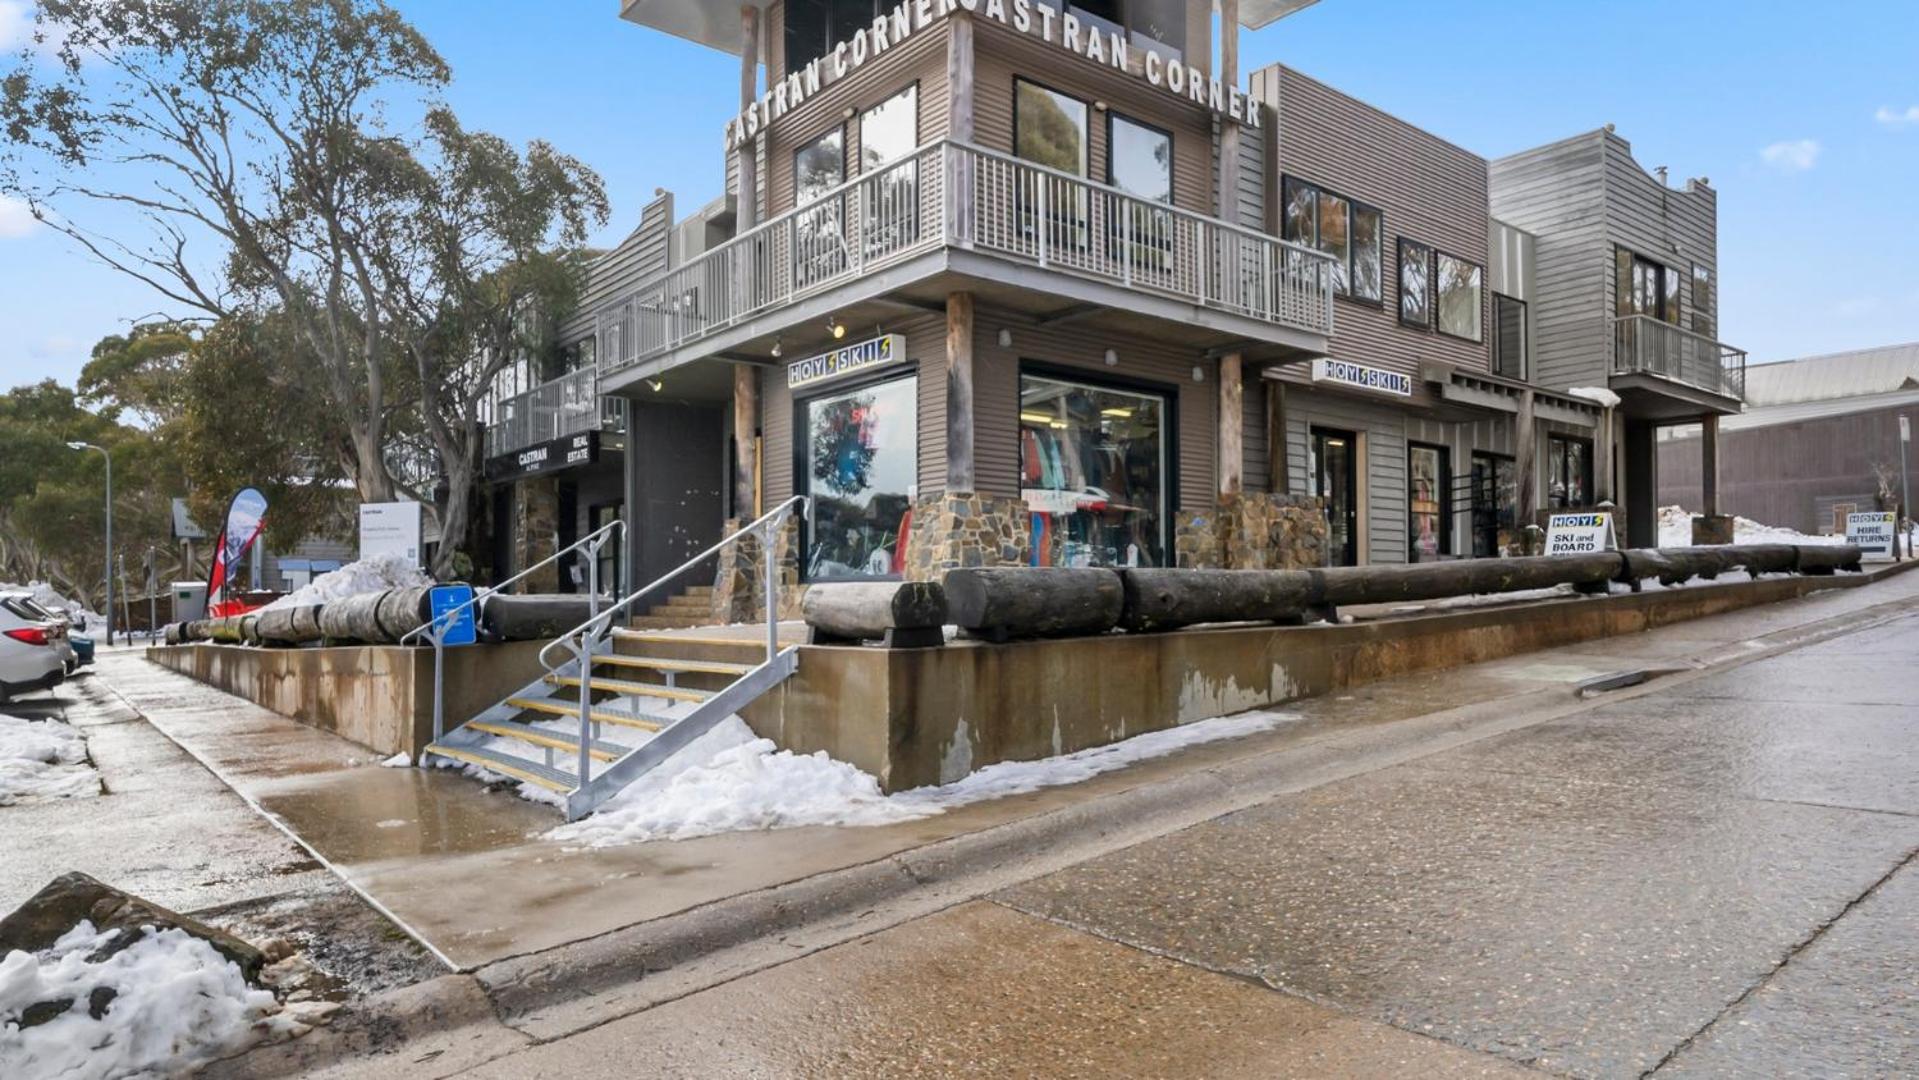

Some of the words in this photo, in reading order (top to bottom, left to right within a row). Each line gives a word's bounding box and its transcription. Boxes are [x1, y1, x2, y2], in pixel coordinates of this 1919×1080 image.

[960, 0, 1127, 71] ASTRAN
[1146, 50, 1260, 127] CORNER
[519, 447, 547, 466] CASTRAN
[567, 448, 588, 463] ESTATE
[1857, 526, 1881, 534] HIRE
[1553, 533, 1574, 542] SKI
[1576, 533, 1594, 542] and
[1847, 534, 1891, 543] RETURNS
[1552, 543, 1595, 552] BOARD
